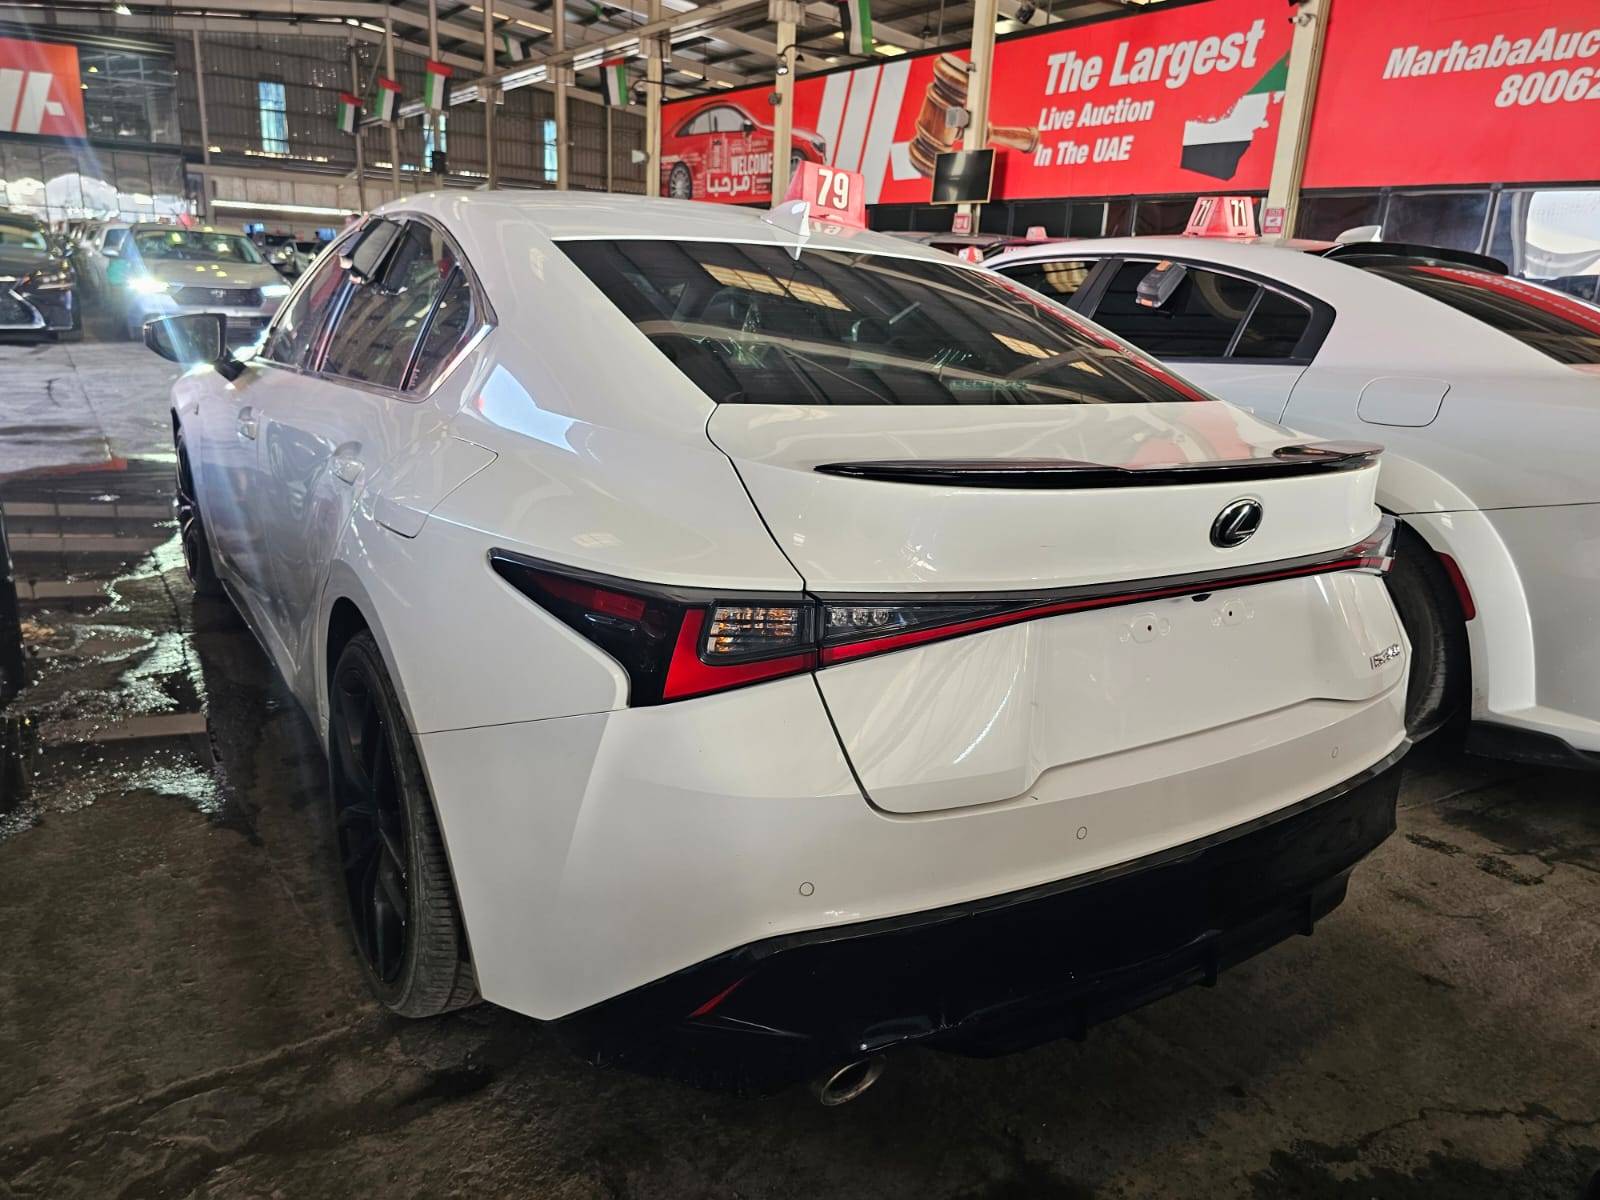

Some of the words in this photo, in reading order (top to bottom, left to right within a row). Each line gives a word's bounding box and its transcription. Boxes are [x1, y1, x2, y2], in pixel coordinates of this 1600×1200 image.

[1045, 51, 1103, 95] The
[1109, 19, 1265, 89] Largest
[1382, 26, 1600, 80] MarhabaAuc
[1038, 107, 1074, 131] Live
[1077, 97, 1155, 128] Auction
[731, 153, 772, 176] WELCOME
[1034, 143, 1051, 167] In
[1056, 140, 1088, 165] The
[1093, 135, 1134, 162] UAE
[707, 172, 750, 198] مرحبا
[817, 168, 849, 210] 79
